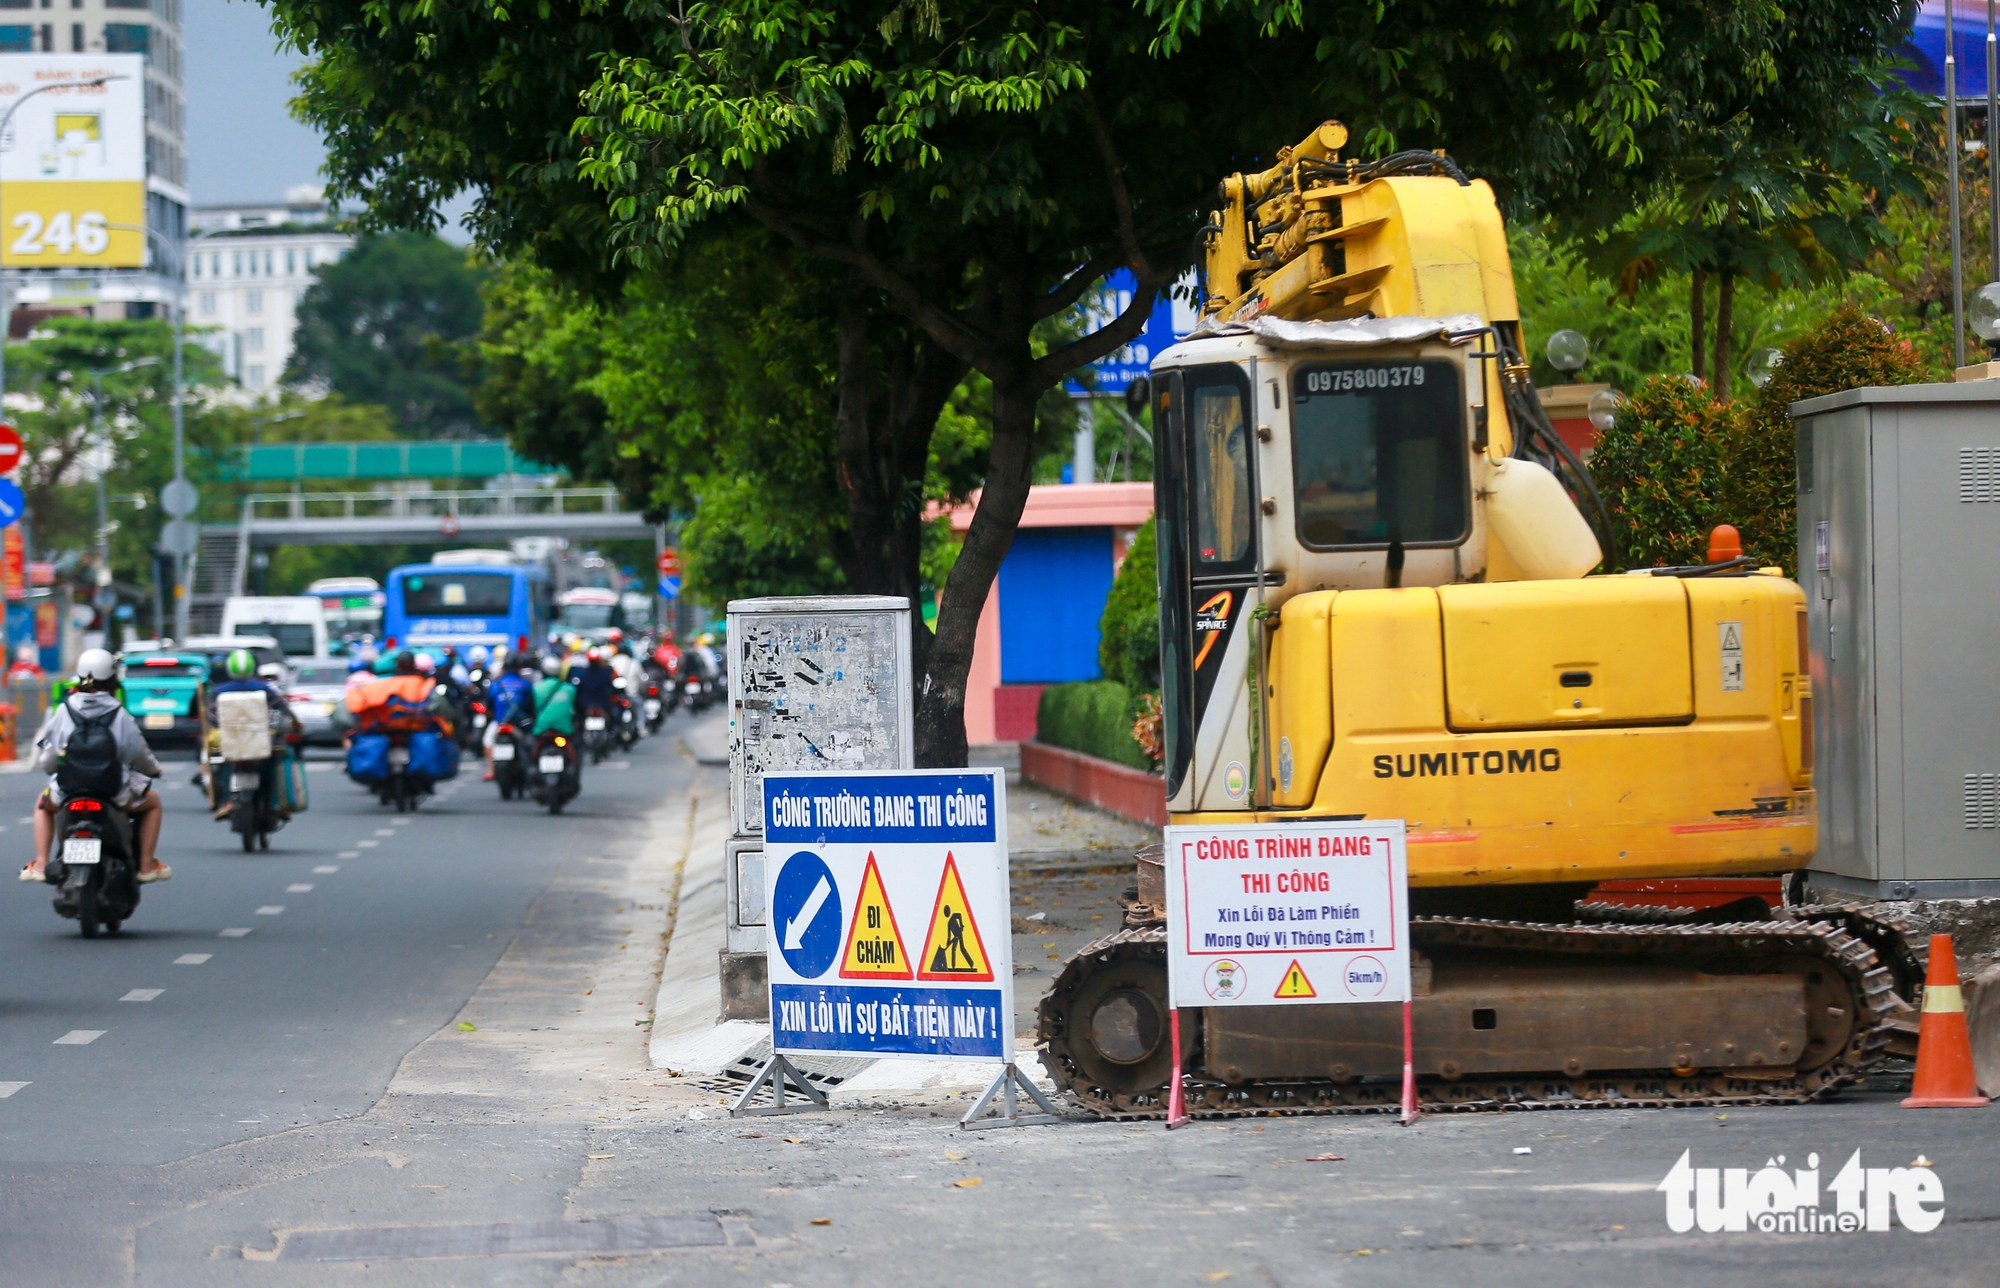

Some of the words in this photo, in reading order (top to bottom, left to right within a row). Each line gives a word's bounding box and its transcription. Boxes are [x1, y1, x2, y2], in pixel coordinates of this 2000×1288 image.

[10, 210, 110, 255] 246
[1307, 366, 1425, 392] 0975800379
[1374, 748, 1560, 778] SUMITOMO
[772, 790, 811, 828] CÔNG
[814, 788, 871, 828] TRƯỜNG
[874, 795, 915, 827] ĐANG
[918, 795, 942, 827] THI
[945, 787, 988, 827] CÔNG
[1196, 835, 1250, 860] CÔNG
[1255, 833, 1312, 858] TRÌNH
[1318, 835, 1372, 857] ĐANG
[1241, 873, 1271, 894] THI
[1277, 868, 1331, 893] CÔNG
[867, 905, 881, 929] ĐI
[1218, 907, 1240, 923] Xin
[1244, 904, 1264, 922] Lỗi
[1268, 906, 1285, 922] Đã
[1289, 906, 1318, 921] Làm
[1205, 932, 1242, 948] Mong
[1246, 931, 1271, 948] Quý
[1275, 931, 1288, 949] Vị
[1291, 930, 1331, 947] Thông
[1335, 928, 1366, 945] Cảm
[856, 936, 896, 969] CHẬM
[1348, 971, 1383, 984] 5km/h
[780, 1000, 806, 1032] XIN
[811, 990, 835, 1033] LỖI
[837, 995, 853, 1034] VÌ
[856, 999, 879, 1042] SỰ
[881, 992, 911, 1037] BẤT
[914, 1001, 951, 1045] TIỆN
[953, 999, 988, 1039] NÀY
